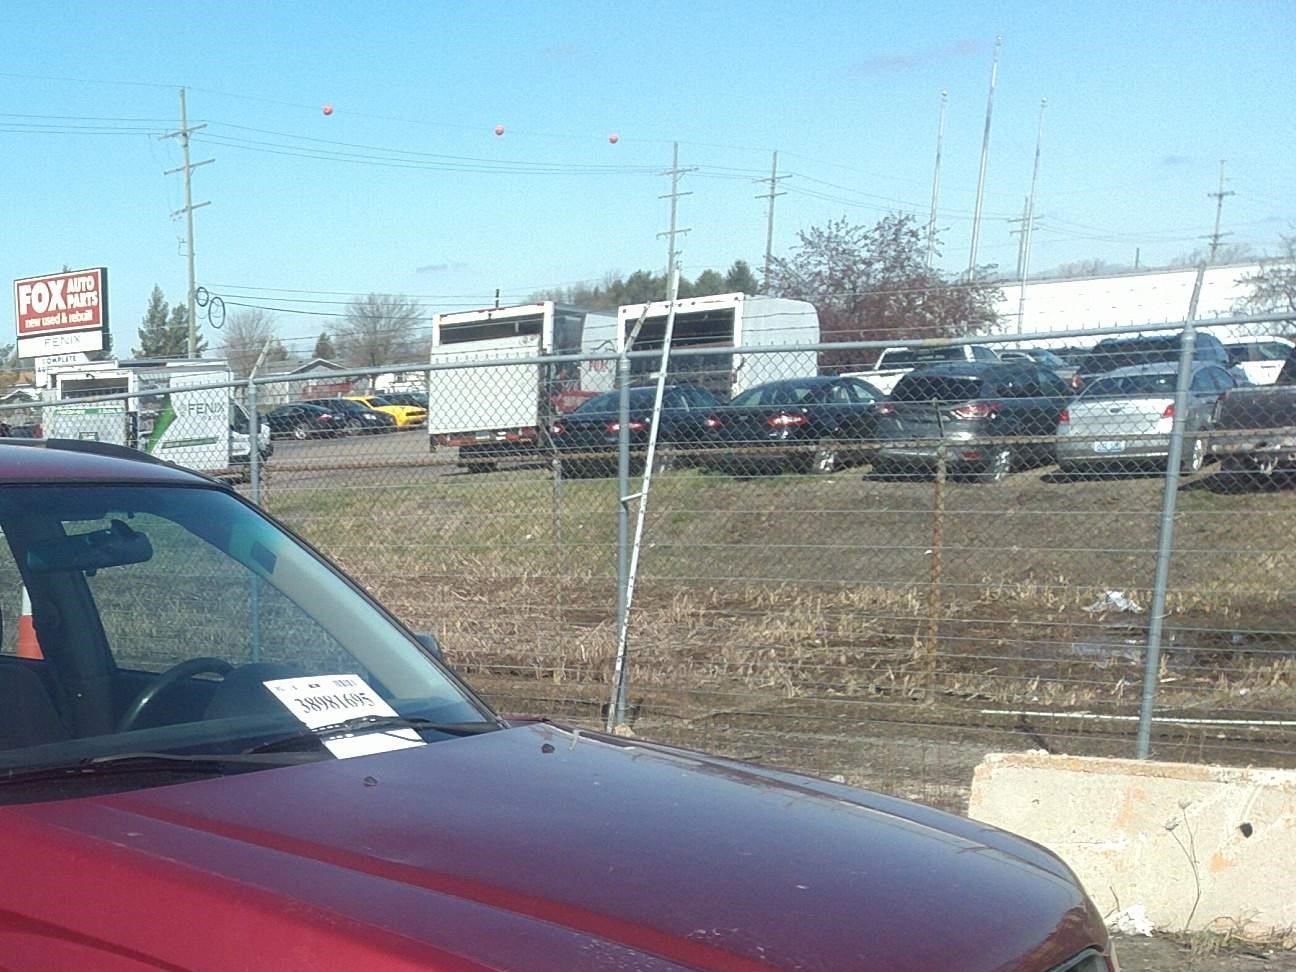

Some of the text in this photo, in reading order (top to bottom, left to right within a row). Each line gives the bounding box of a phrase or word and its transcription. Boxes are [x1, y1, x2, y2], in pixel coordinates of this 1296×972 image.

[67, 276, 94, 292] AUTO
[19, 279, 66, 315] FOX
[67, 291, 98, 308] PARTS
[44, 335, 80, 345] FENIX
[188, 402, 224, 415] FENIX
[294, 692, 375, 713] 38981695
